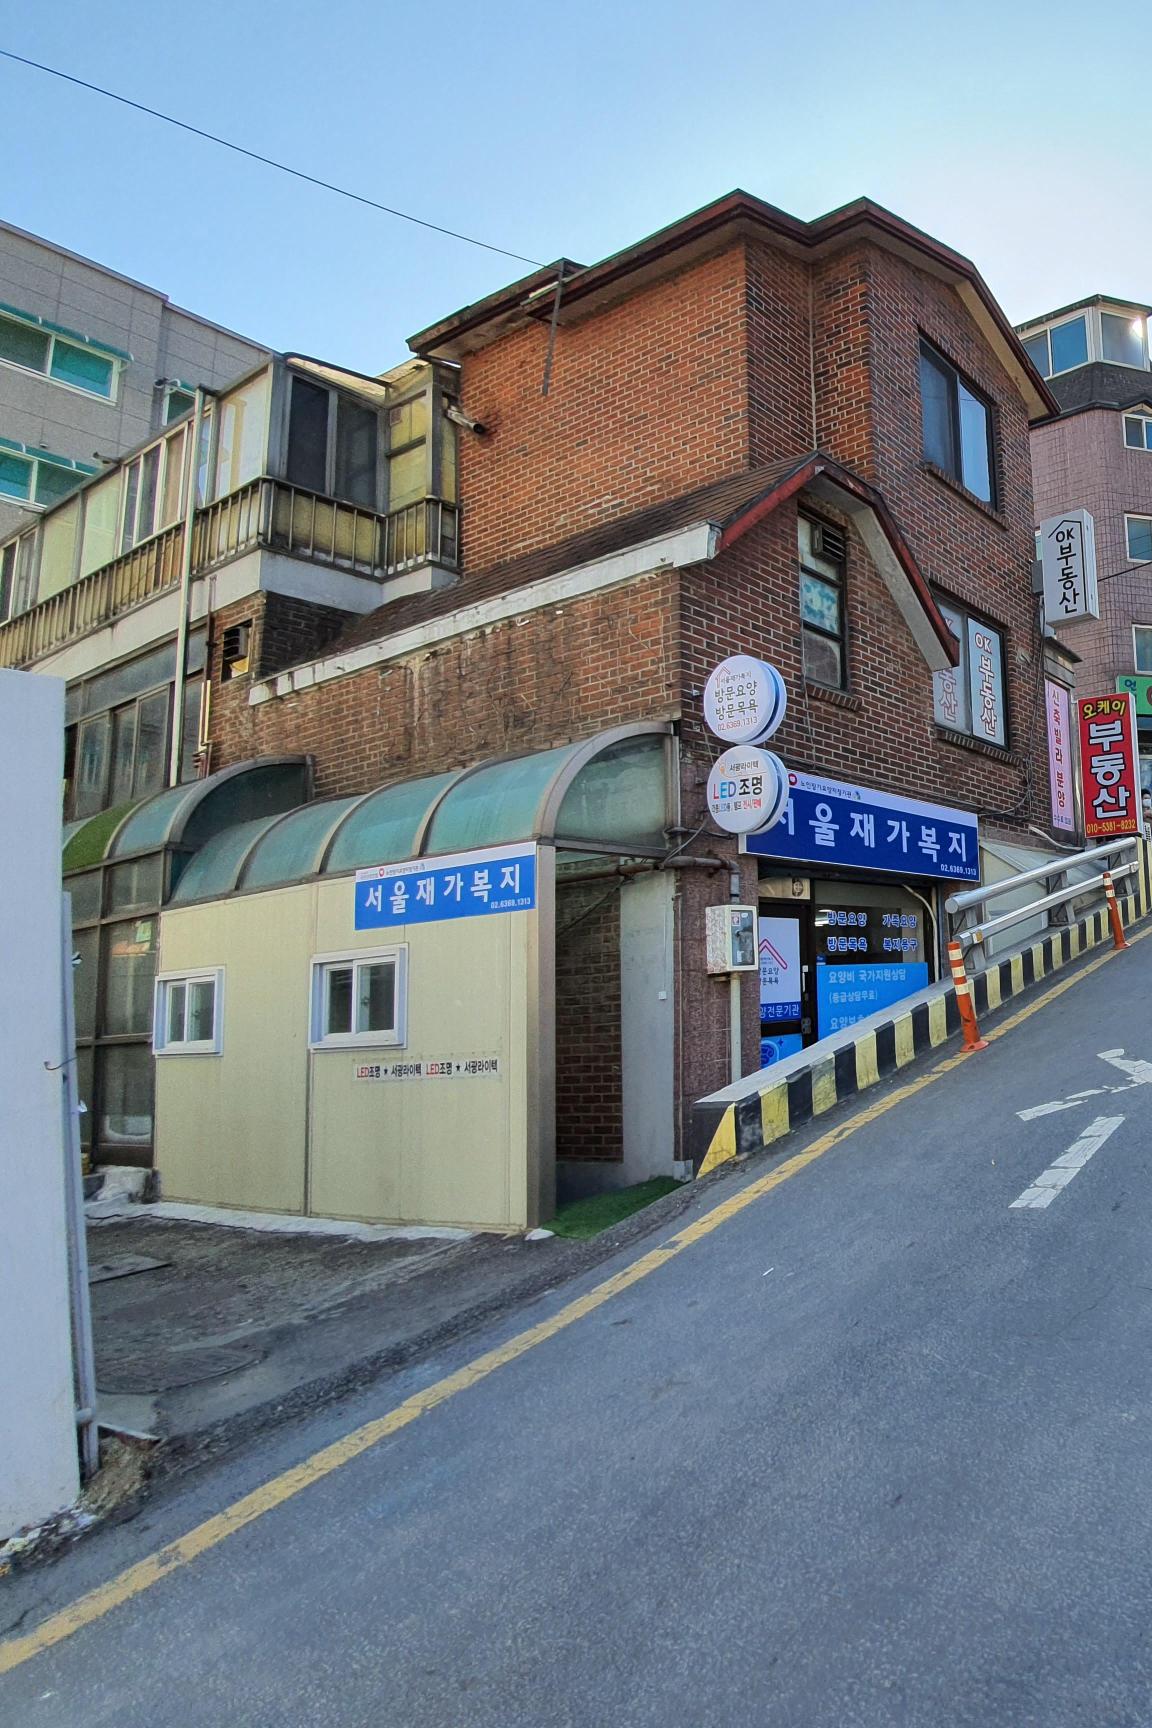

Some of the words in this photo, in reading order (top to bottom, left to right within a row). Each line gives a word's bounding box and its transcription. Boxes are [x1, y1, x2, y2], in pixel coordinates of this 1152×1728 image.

[1056, 528, 1075, 542] OK
[1057, 543, 1079, 613] 부동산
[974, 632, 993, 654] OK
[715, 680, 757, 703] 방문요양
[979, 655, 998, 737] 부동산
[716, 699, 758, 720] 방문목욕
[1083, 700, 1126, 719] 오케이
[718, 717, 758, 731] 02.6369.1313
[1089, 720, 1131, 819] 부동산
[713, 781, 737, 799] LED
[738, 774, 763, 796] 조명
[365, 863, 520, 914] 서울재가복지
[827, 911, 867, 927] 방문요양
[827, 936, 868, 952] 방문목욕
[357, 1066, 380, 1079] LED조명
[426, 1062, 453, 1076] LED조명
